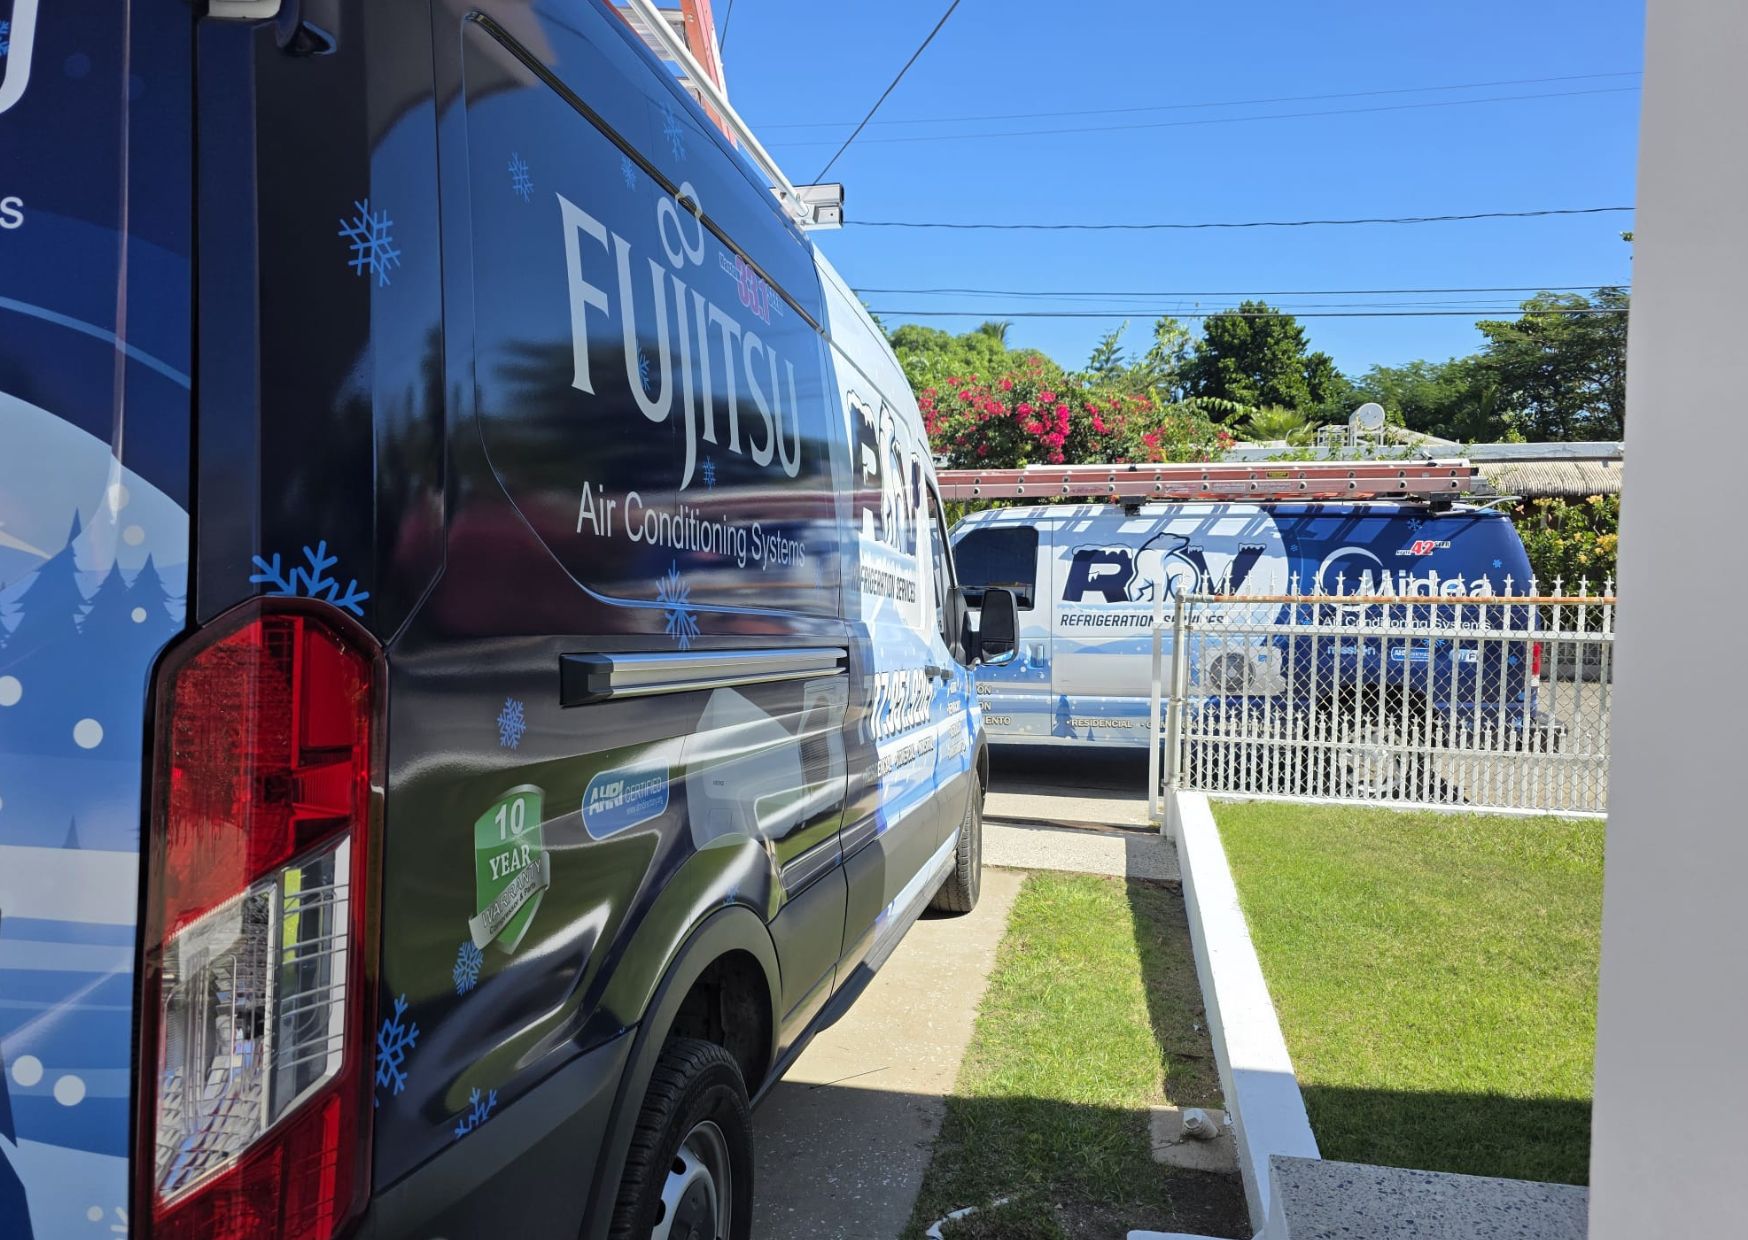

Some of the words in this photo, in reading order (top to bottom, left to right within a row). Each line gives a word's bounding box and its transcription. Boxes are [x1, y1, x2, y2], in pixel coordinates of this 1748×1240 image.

[556, 191, 801, 492] FUJITSU
[576, 480, 616, 536] Air
[625, 491, 747, 569] Conditioning
[751, 523, 806, 571] Systems
[1411, 540, 1435, 555] 42
[1350, 569, 1492, 598] Midea
[1060, 614, 1154, 627] REFRIGERATION
[1071, 718, 1133, 729] RESIDENCIAL
[624, 776, 662, 804] CERTIFIED
[494, 797, 526, 841] 10
[489, 844, 532, 881] YEAR
[481, 859, 541, 929] WARRANTY
